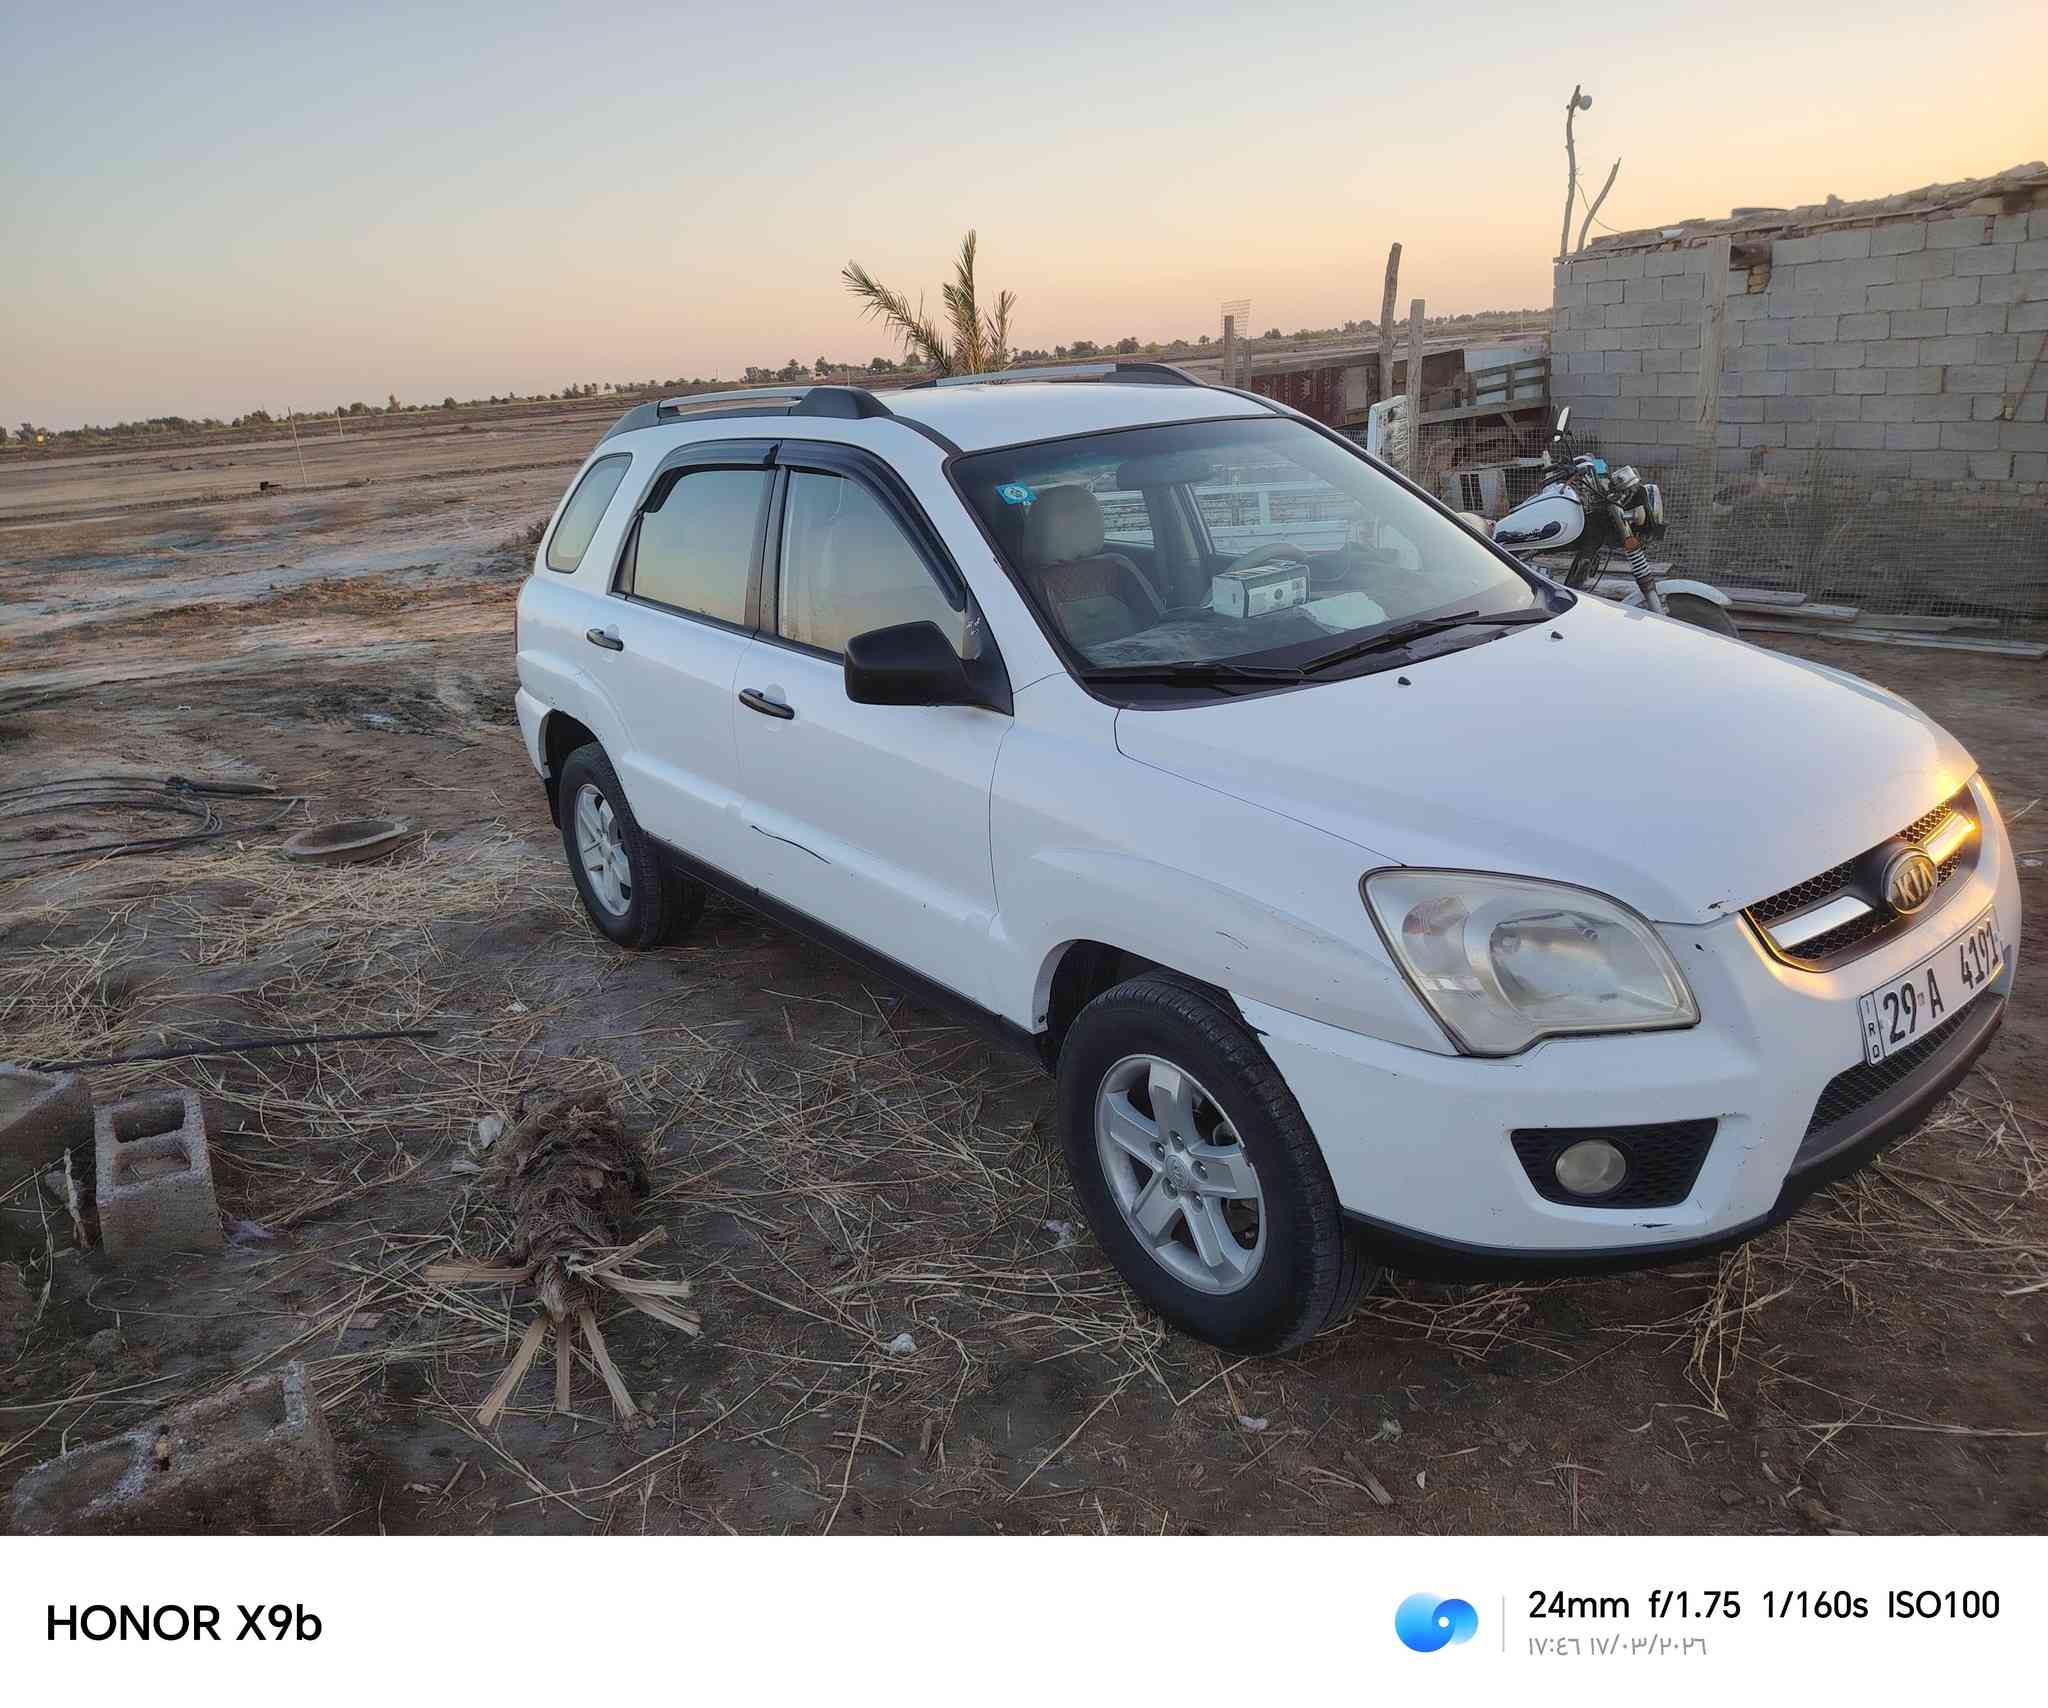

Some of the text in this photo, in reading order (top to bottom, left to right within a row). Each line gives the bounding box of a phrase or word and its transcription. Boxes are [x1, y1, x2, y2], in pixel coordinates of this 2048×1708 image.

[1894, 861, 1935, 906] KIA
[1883, 918, 1999, 1044] 29 A 4191
